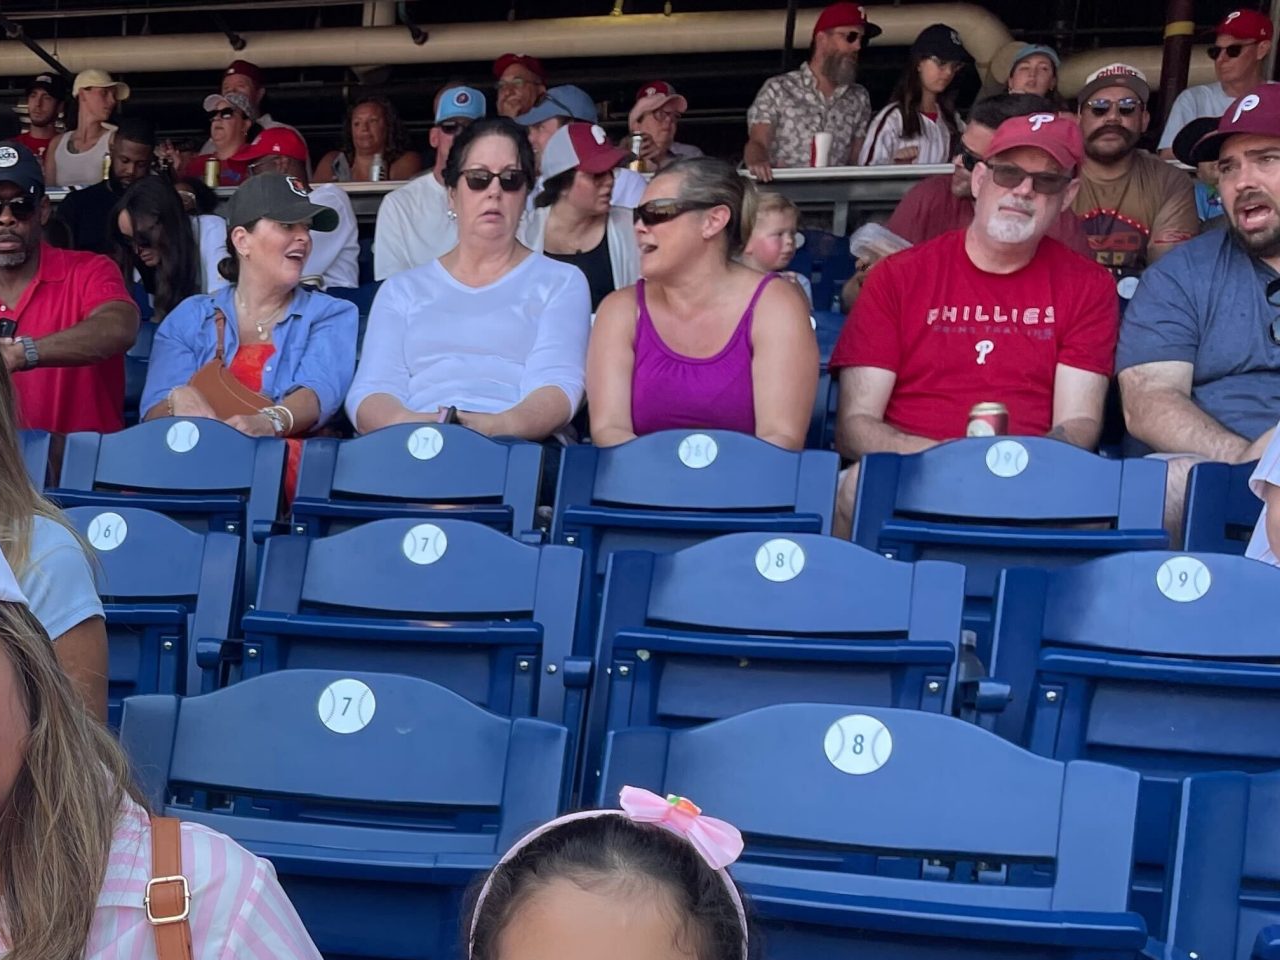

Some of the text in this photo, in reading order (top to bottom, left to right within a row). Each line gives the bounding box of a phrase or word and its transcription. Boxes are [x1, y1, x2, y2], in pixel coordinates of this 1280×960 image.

[1232, 94, 1260, 124] P
[1028, 113, 1055, 131] P
[926, 305, 1056, 326] PHILLIES
[975, 340, 995, 365] P
[103, 524, 111, 539] 6
[420, 536, 430, 553] 7
[775, 552, 785, 569] 8
[1179, 570, 1189, 588] 9
[341, 696, 353, 716] 7
[852, 734, 865, 755] 8
